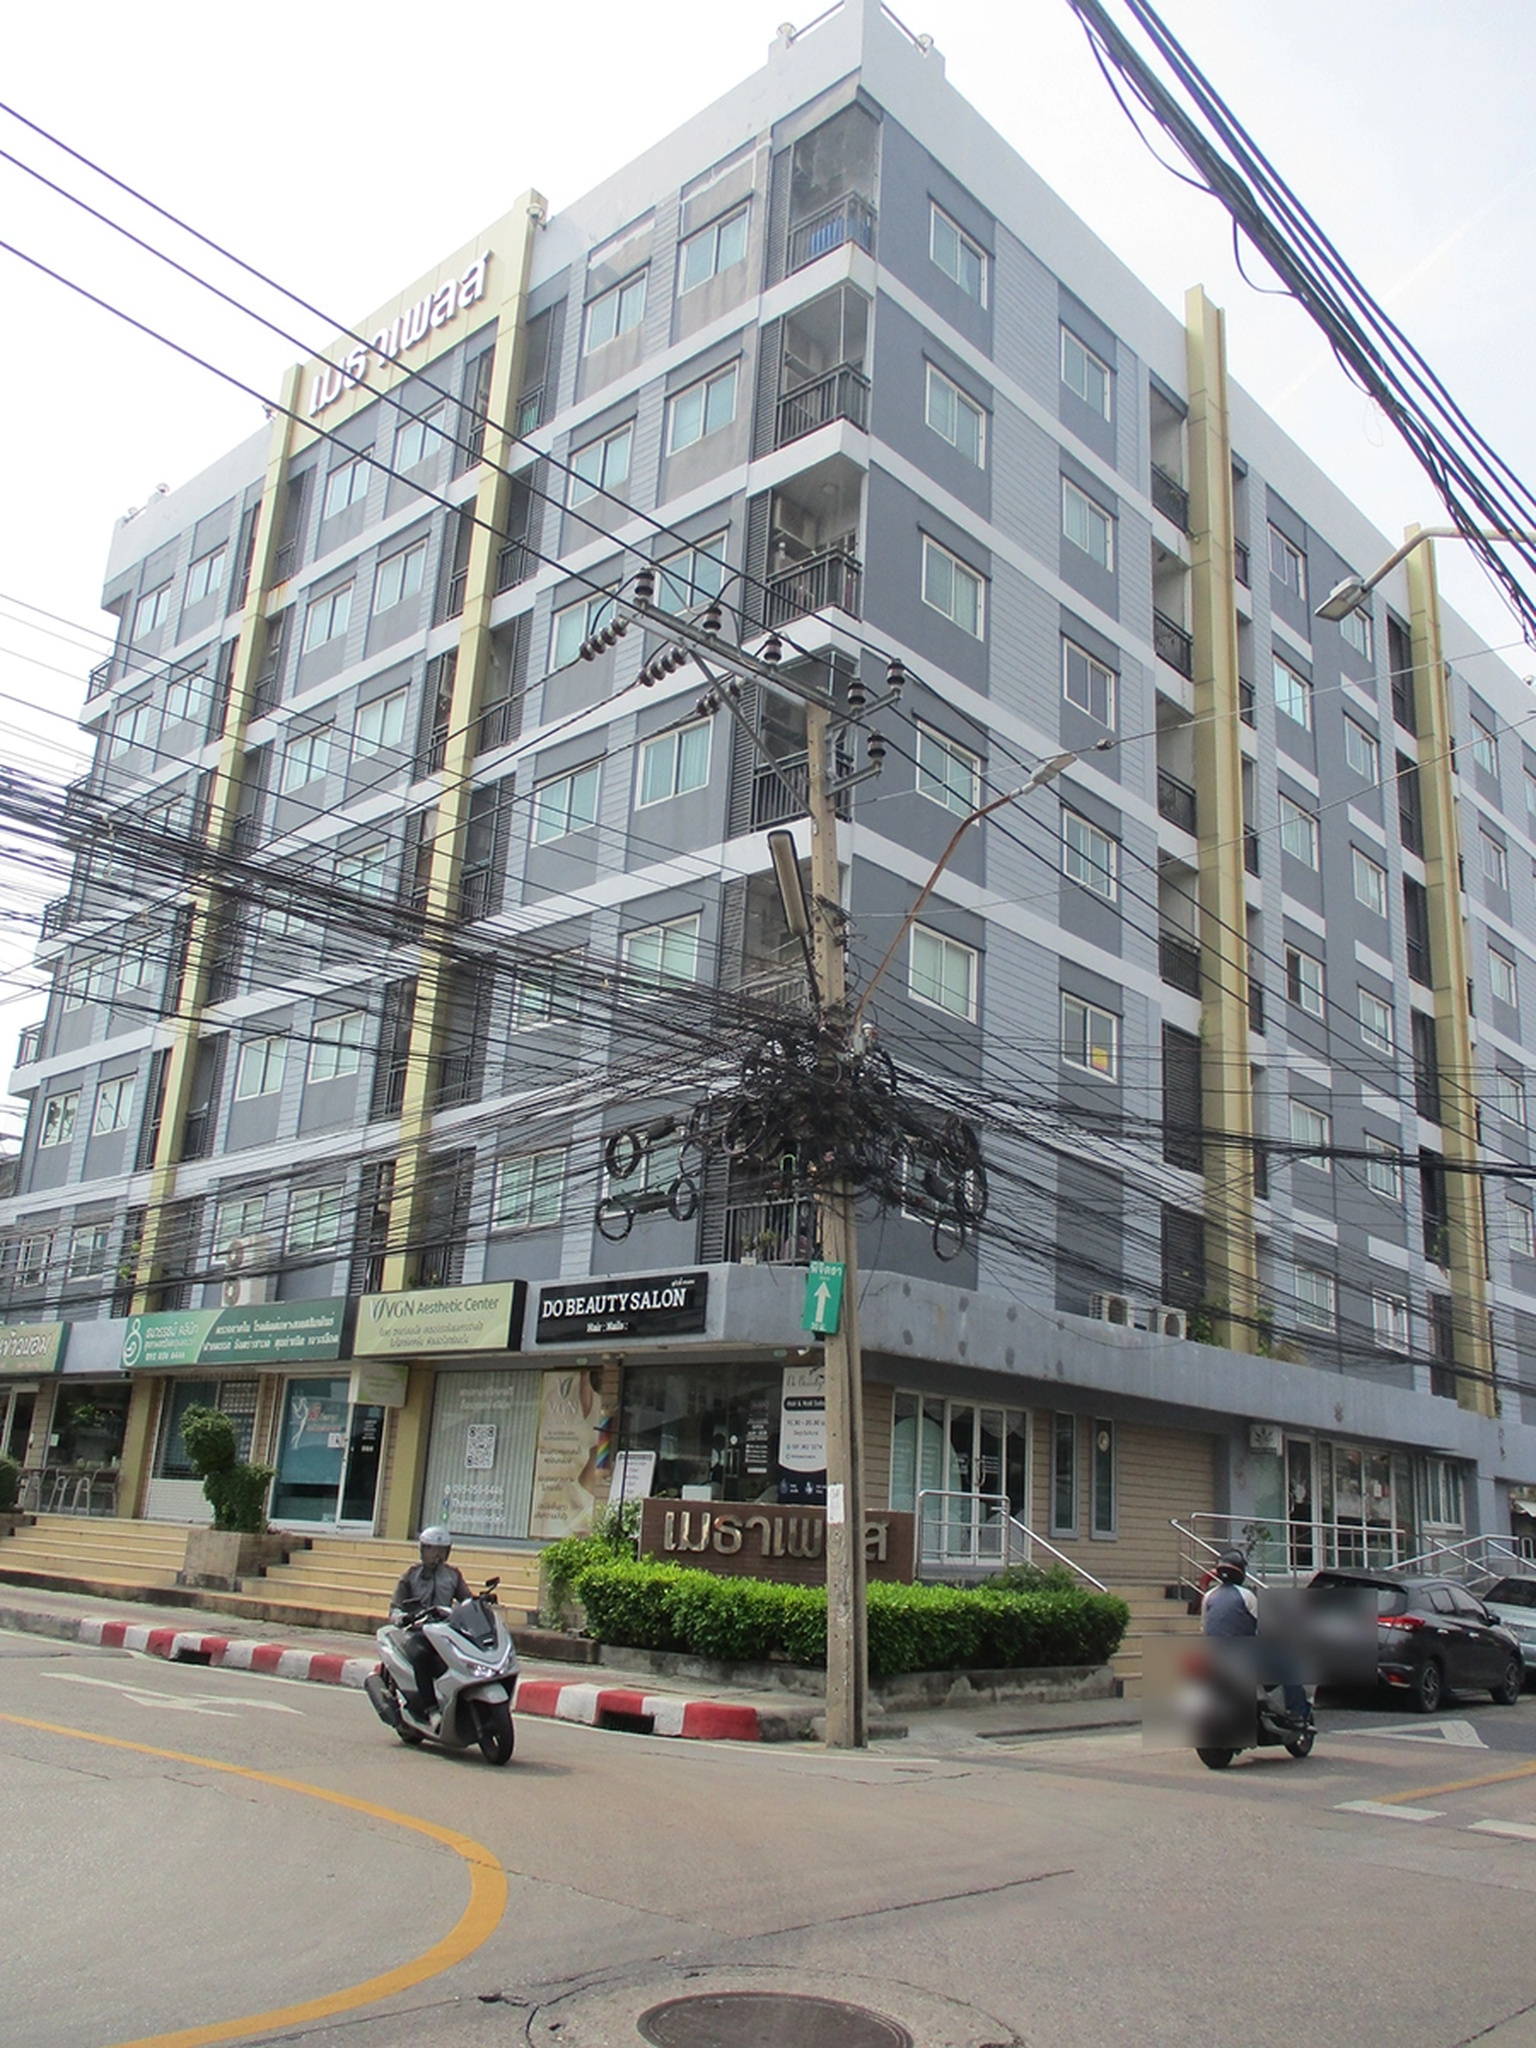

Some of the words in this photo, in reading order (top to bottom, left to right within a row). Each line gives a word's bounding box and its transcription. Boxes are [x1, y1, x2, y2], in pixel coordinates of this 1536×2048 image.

[309, 249, 494, 417] เมธาเพลส
[385, 1300, 415, 1318] VGN
[416, 1298, 462, 1315] Aesthetic
[464, 1297, 499, 1311] Center
[542, 1299, 563, 1318] DO
[565, 1292, 629, 1316] BEAUTY
[630, 1287, 687, 1311] SALON
[663, 1511, 890, 1562] เมธาเพส
